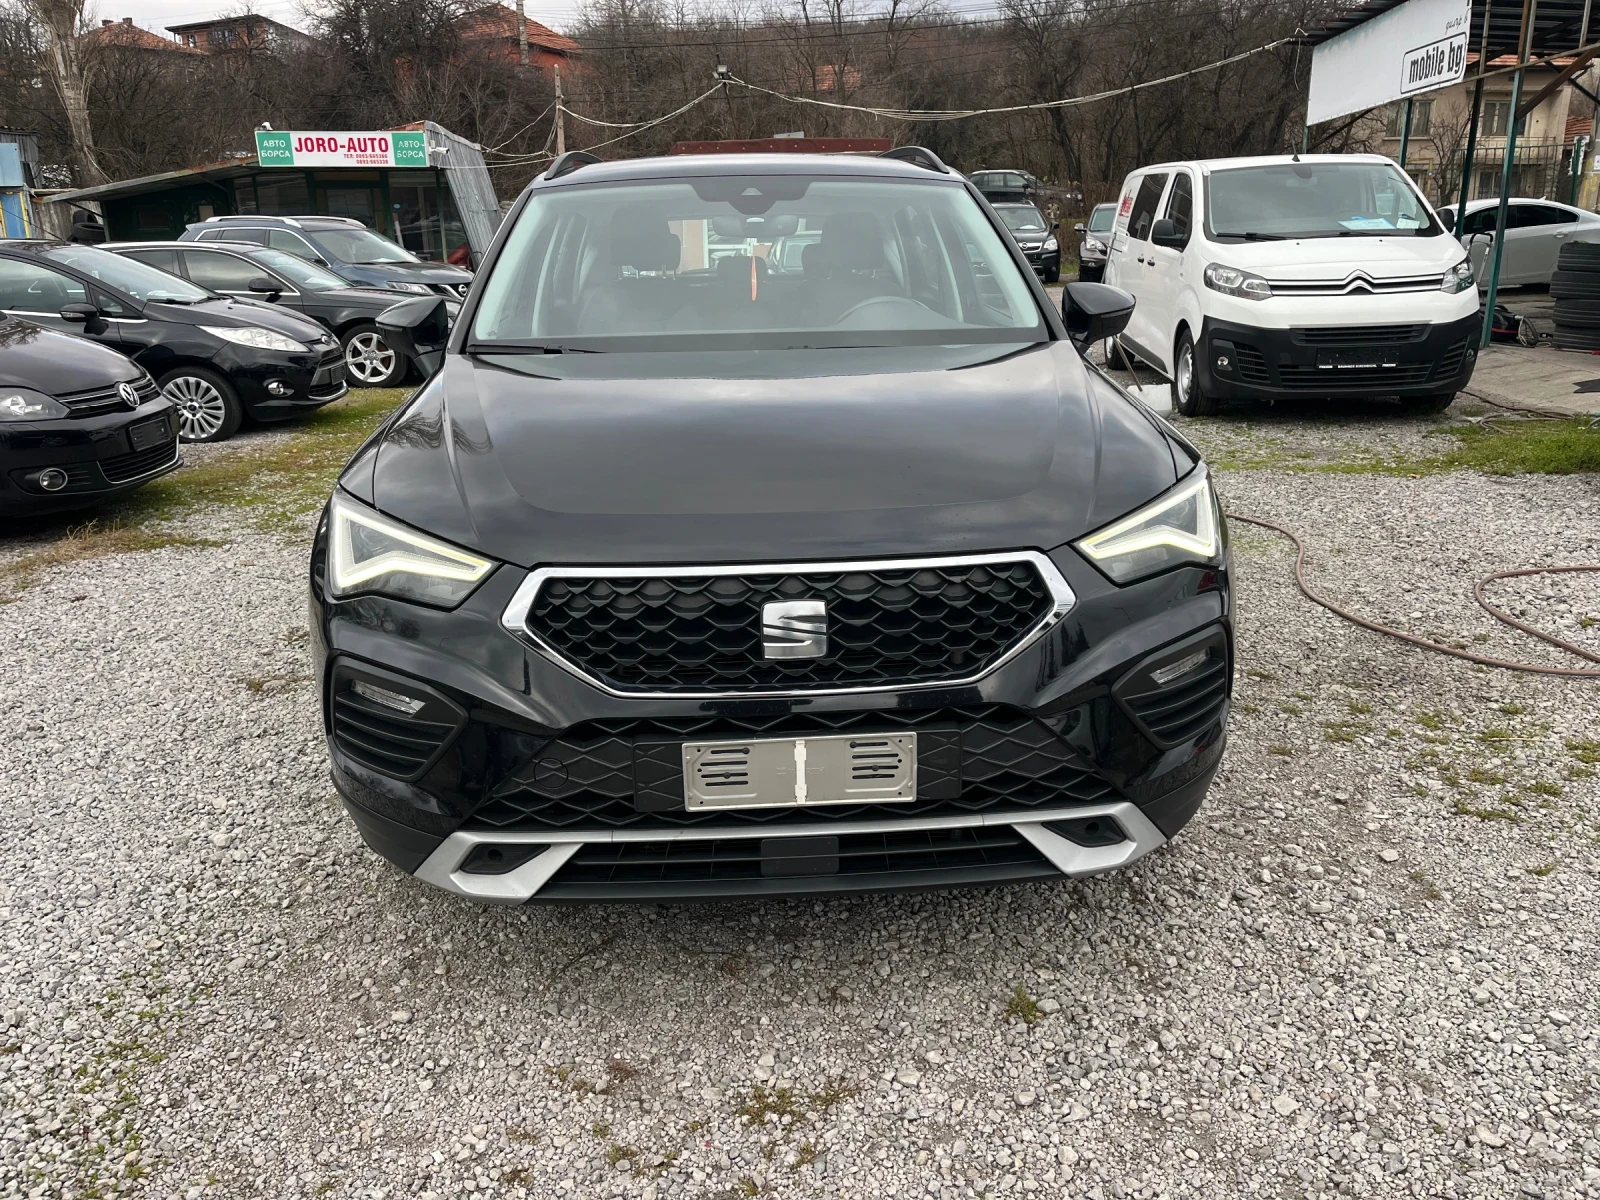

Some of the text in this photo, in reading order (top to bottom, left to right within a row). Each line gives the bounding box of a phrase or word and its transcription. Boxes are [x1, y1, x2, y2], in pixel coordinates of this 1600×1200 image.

[1408, 45, 1445, 83] mobile
[295, 137, 389, 153] JORO-AUTO
[261, 150, 291, 158] БОРСА
[396, 150, 424, 158] БОРСА
